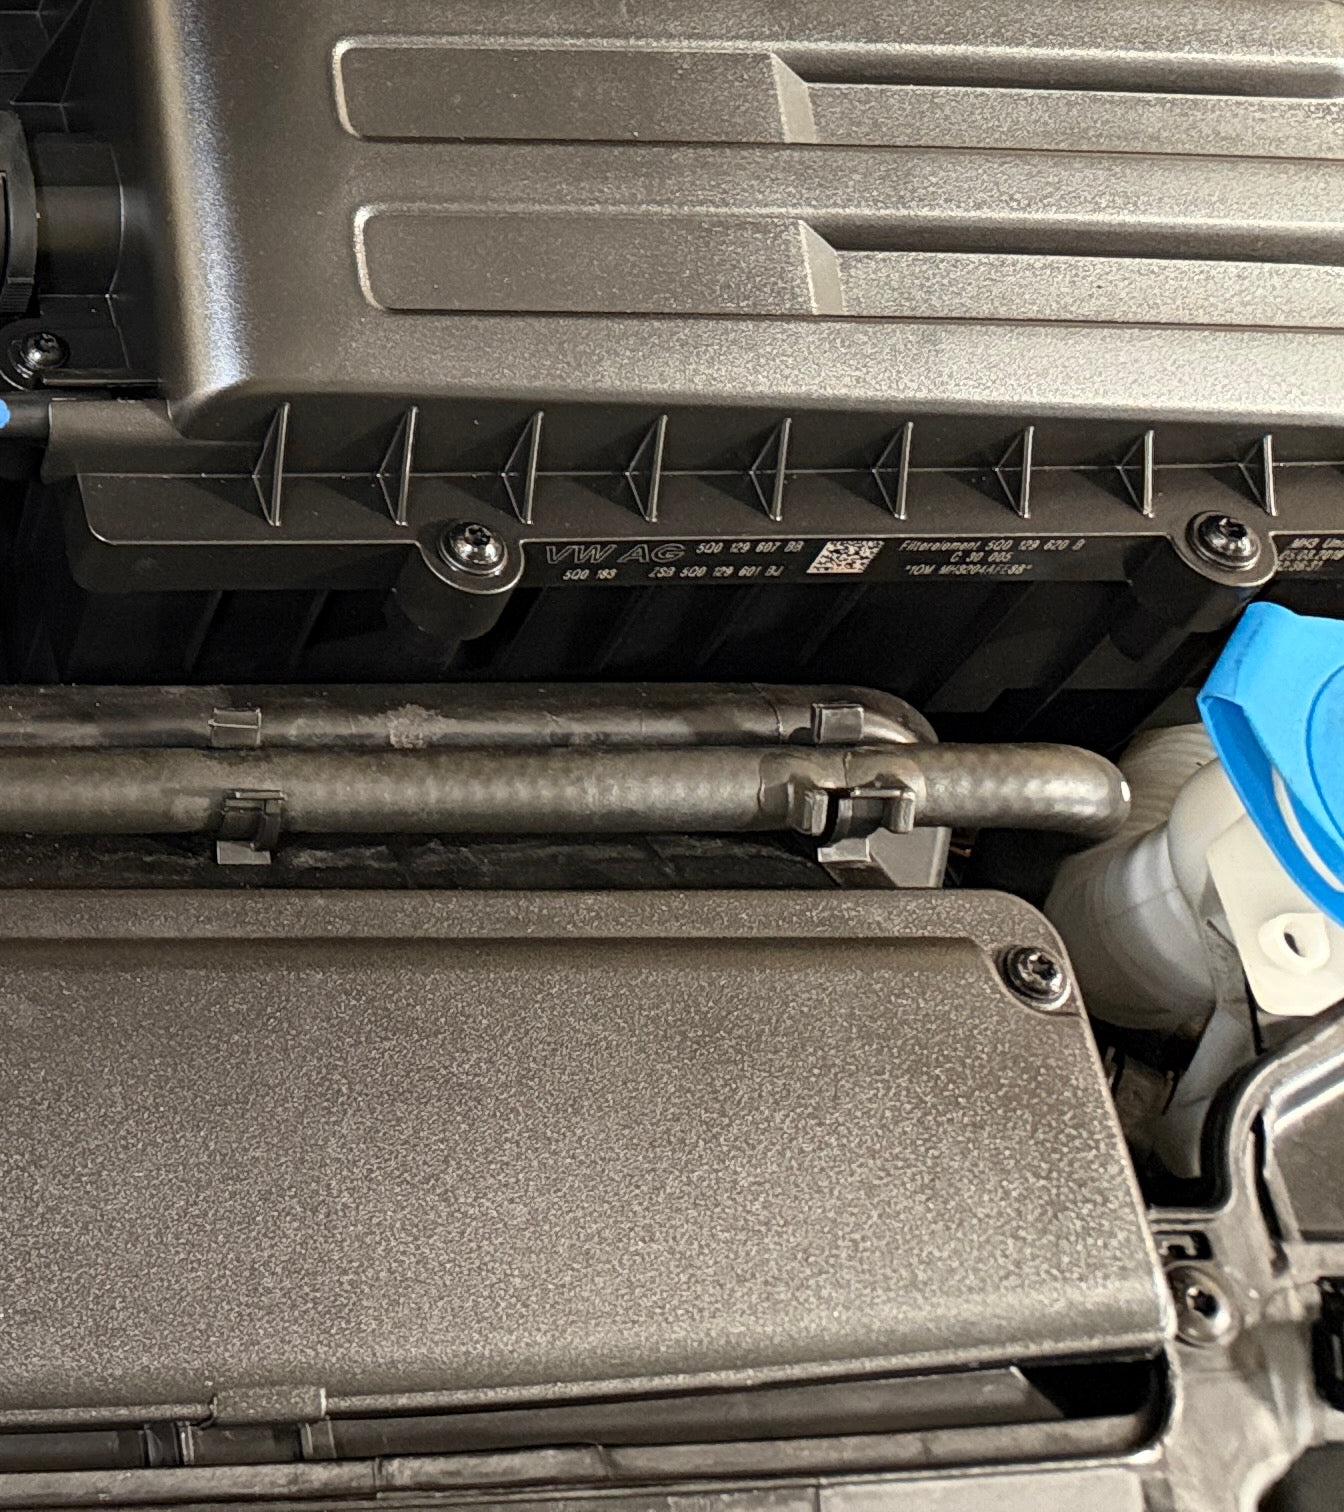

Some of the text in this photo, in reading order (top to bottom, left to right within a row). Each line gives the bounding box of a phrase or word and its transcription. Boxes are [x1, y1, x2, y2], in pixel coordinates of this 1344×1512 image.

[1018, 538, 1042, 551] 129
[545, 544, 619, 565] VW
[616, 543, 686, 565] AG
[730, 542, 752, 554] 129
[755, 541, 783, 554] 607
[950, 551, 963, 563] C
[965, 551, 985, 563] 30
[712, 565, 735, 578] 129
